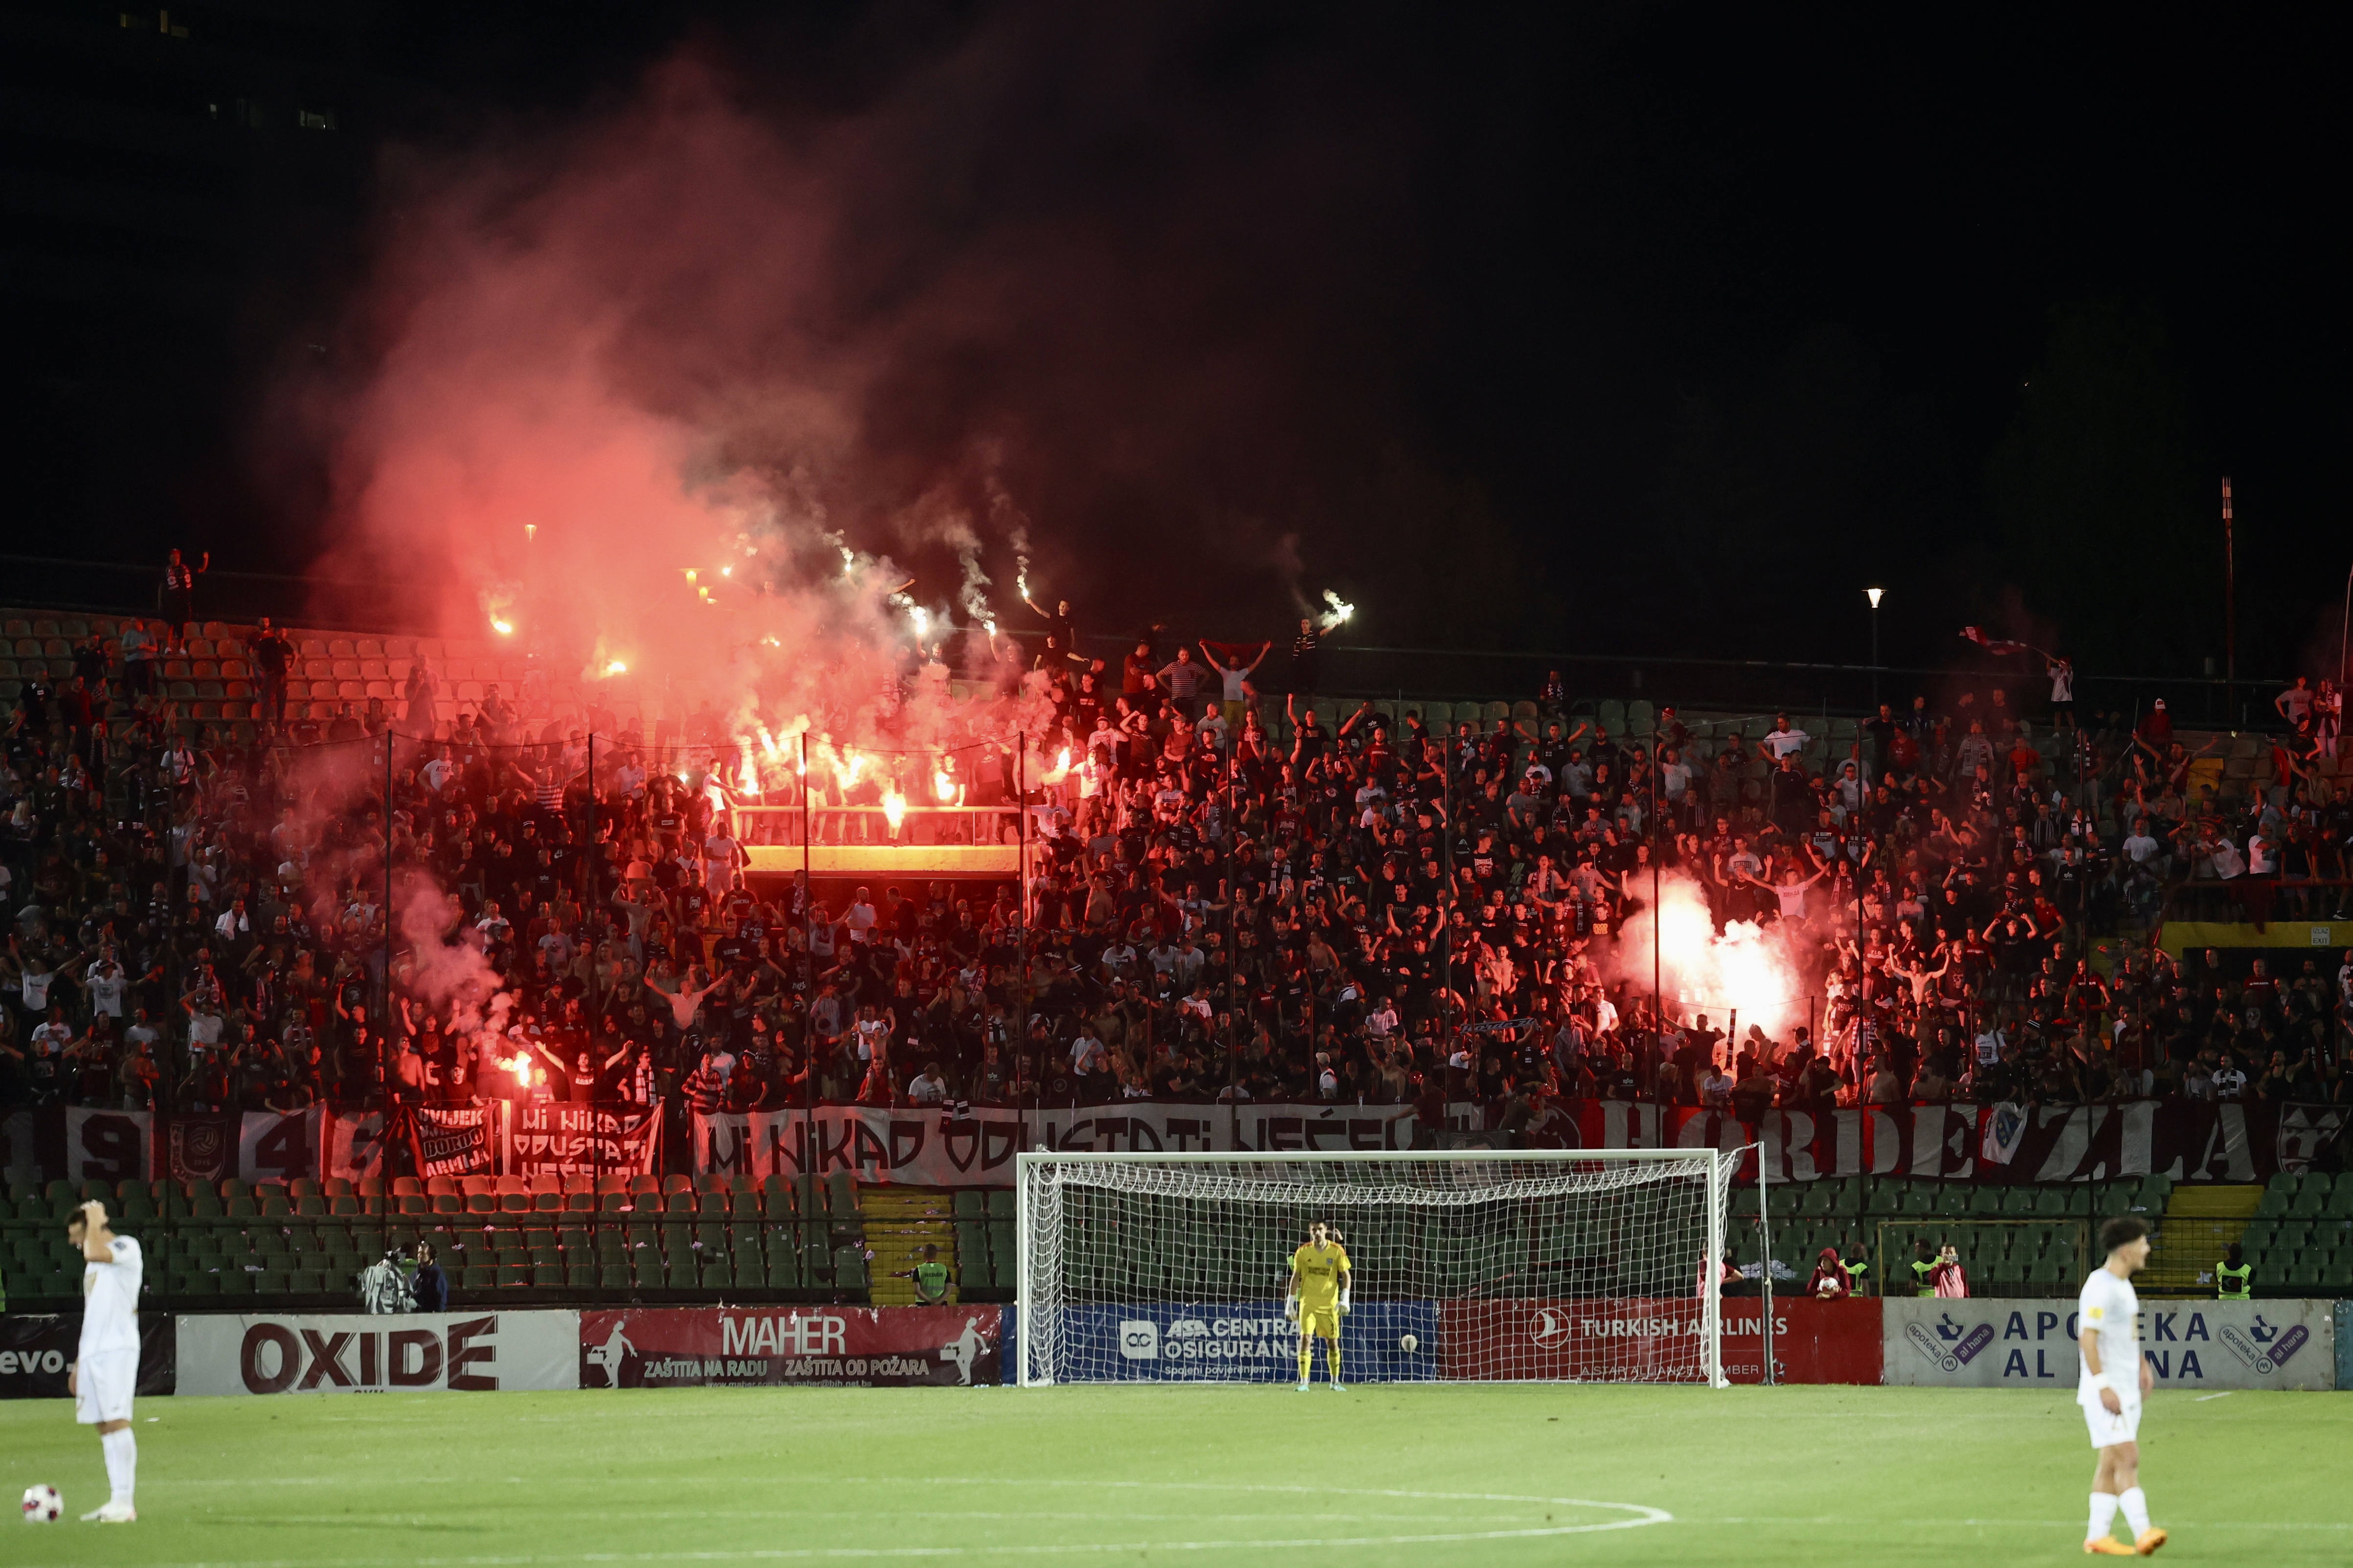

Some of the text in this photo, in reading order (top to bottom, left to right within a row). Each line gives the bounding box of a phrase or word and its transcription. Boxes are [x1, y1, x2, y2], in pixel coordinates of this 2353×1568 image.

[418, 1108, 485, 1126] UVIJEK
[423, 1128, 484, 1158] BORDO
[1599, 1100, 2257, 1183] HORDE ZLA
[426, 1148, 490, 1177] ARMIJA
[722, 1316, 846, 1356] MAHER
[1212, 1318, 1302, 1337] CENTRA
[1581, 1317, 1678, 1337] TURKISH
[1909, 1325, 1941, 1359] apoteka
[240, 1314, 499, 1394] OXIDE
[1959, 1329, 1990, 1358] al hana
[2223, 1329, 2256, 1361] apoteka
[2275, 1330, 2305, 1360] al hana
[644, 1355, 930, 1378] ZAŠTITA NA RADU ZAŠTITA OD POŽARA
[1593, 1365, 1627, 1376] STAR
[2004, 1348, 2055, 1378] AL
